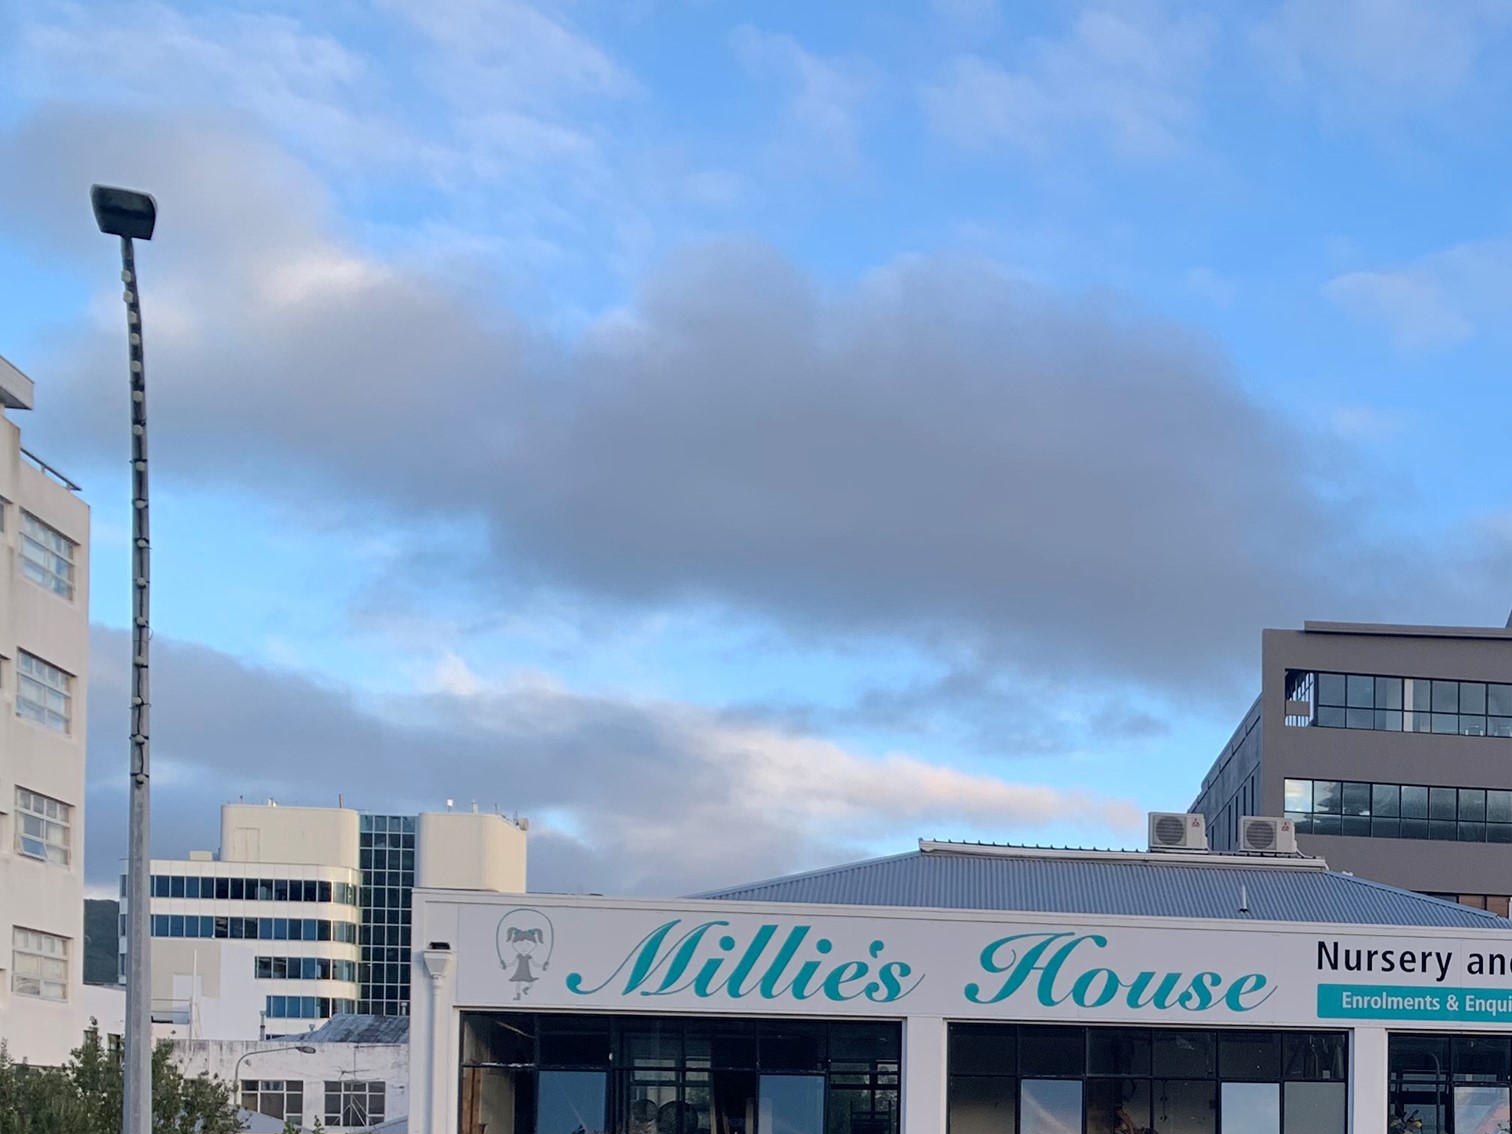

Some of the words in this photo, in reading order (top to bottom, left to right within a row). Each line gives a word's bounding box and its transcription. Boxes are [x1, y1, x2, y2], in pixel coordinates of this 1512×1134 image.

[565, 918, 926, 1003] Millie's
[963, 931, 1278, 1012] House
[1317, 940, 1452, 982] Nursery
[1342, 991, 1441, 1011] Enrolments
[1446, 994, 1459, 1012] &
